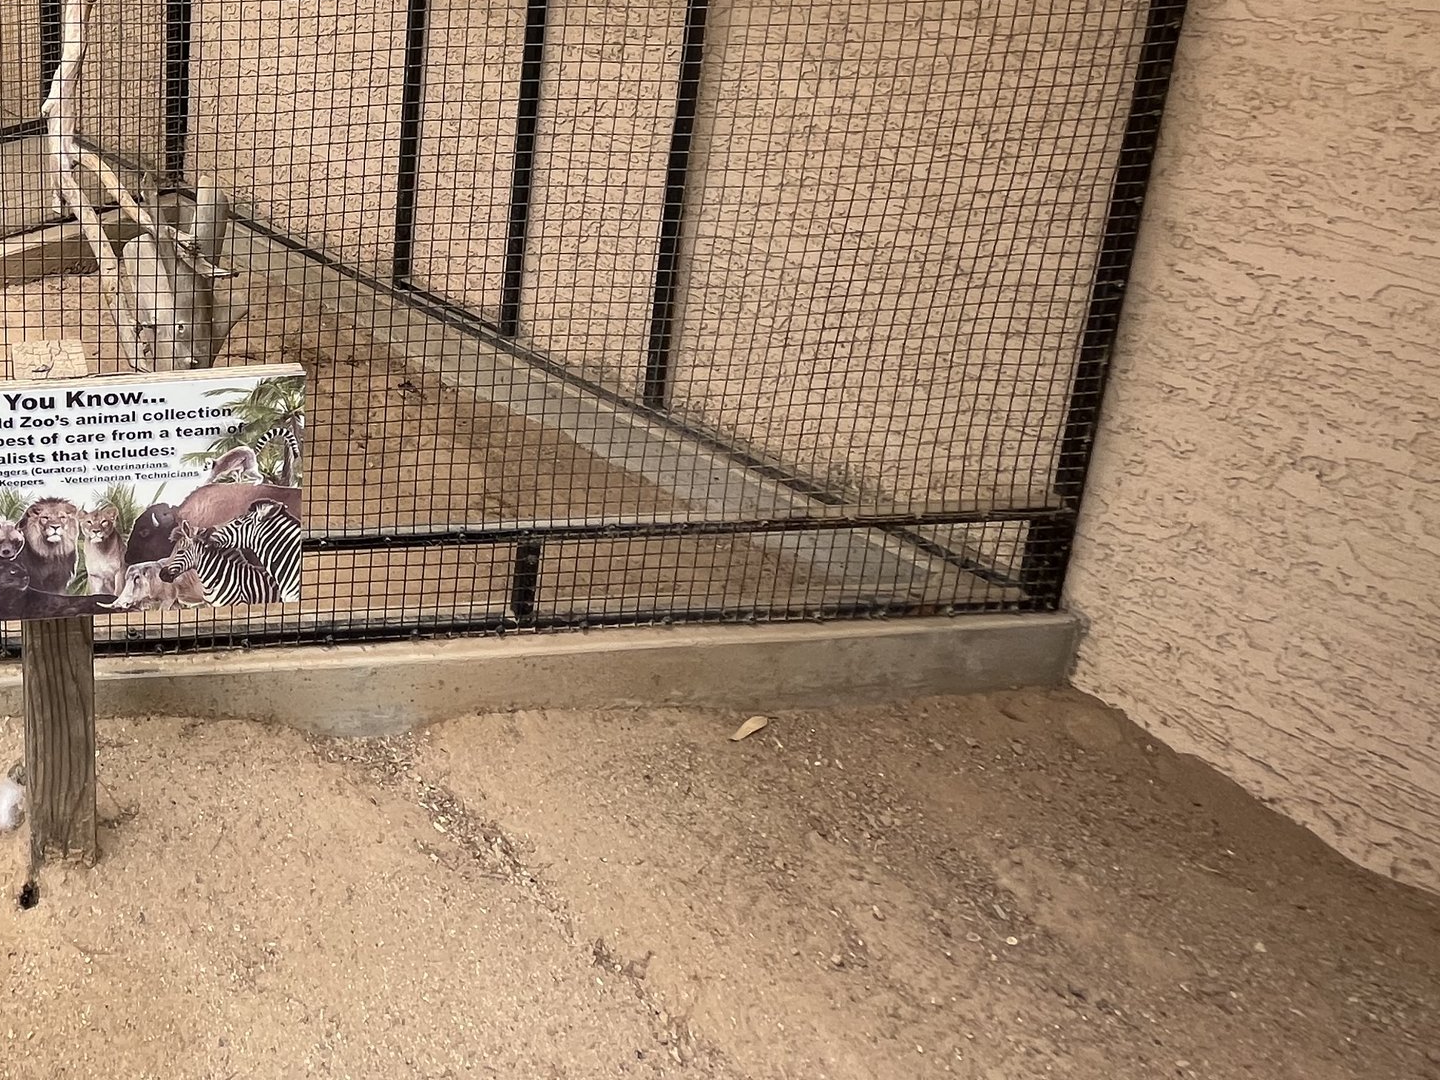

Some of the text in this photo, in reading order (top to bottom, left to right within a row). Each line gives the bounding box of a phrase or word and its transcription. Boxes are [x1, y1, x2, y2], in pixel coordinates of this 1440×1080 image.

[3, 391, 54, 411] You
[66, 386, 165, 407] Know...
[75, 411, 135, 425] animal
[142, 405, 231, 421] collection
[40, 433, 58, 444] of
[65, 432, 105, 443] care
[111, 428, 152, 441] from
[159, 429, 169, 438] a
[175, 424, 220, 437] team
[227, 422, 244, 434] of
[51, 449, 88, 462] that
[94, 444, 175, 459] includes:
[31, 464, 86, 475] (Curators)
[135, 469, 199, 480] Technicians
